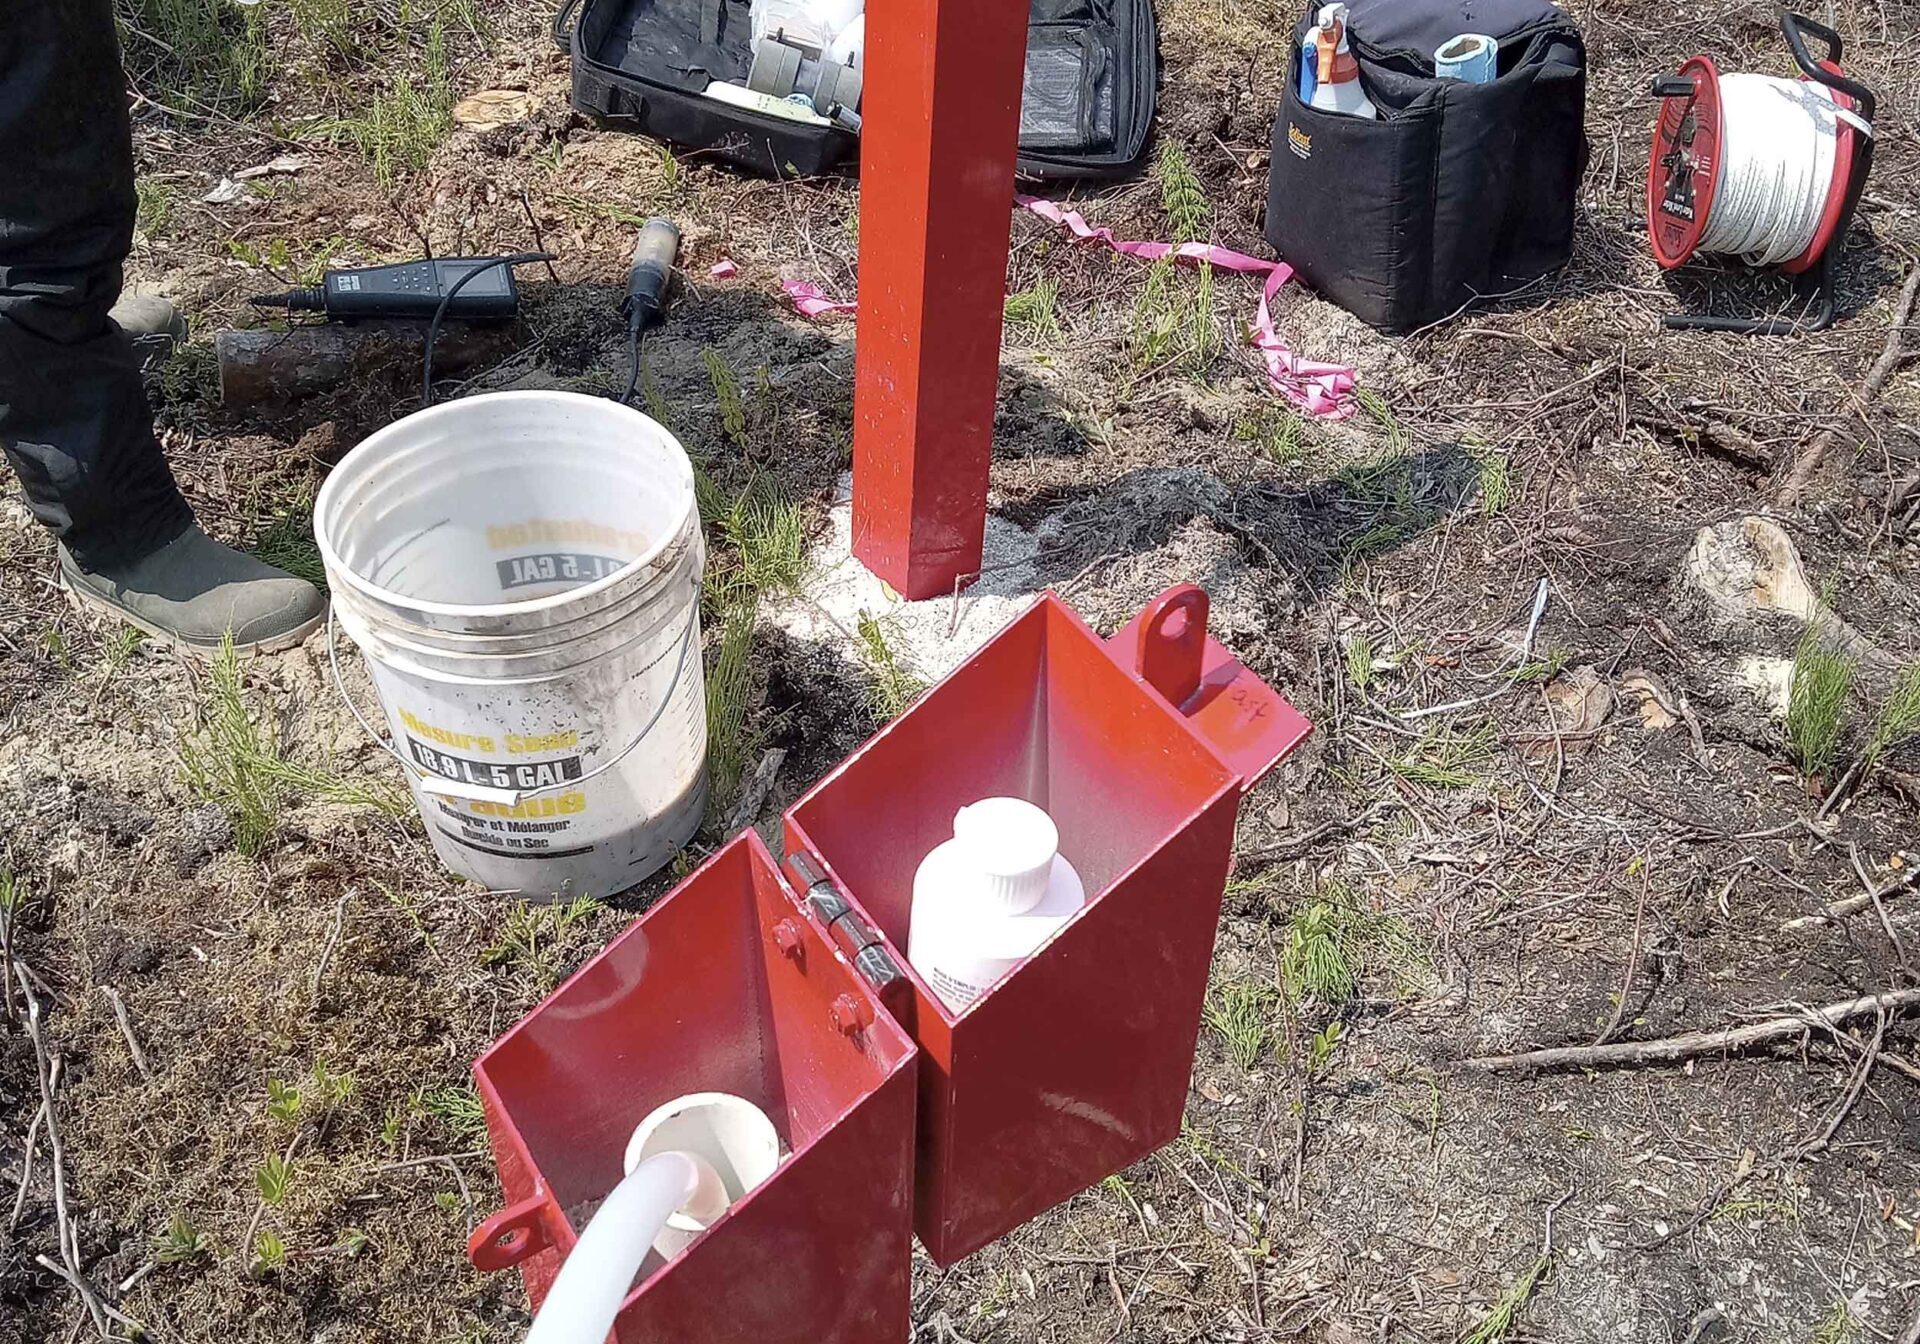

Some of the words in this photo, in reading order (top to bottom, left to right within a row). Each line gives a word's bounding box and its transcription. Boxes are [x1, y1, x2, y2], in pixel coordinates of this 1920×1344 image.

[412, 742, 459, 778] 18.9
[515, 761, 567, 788] GAL
[490, 820, 505, 832] et
[507, 838, 522, 849] ou
[522, 837, 550, 849] Sec
